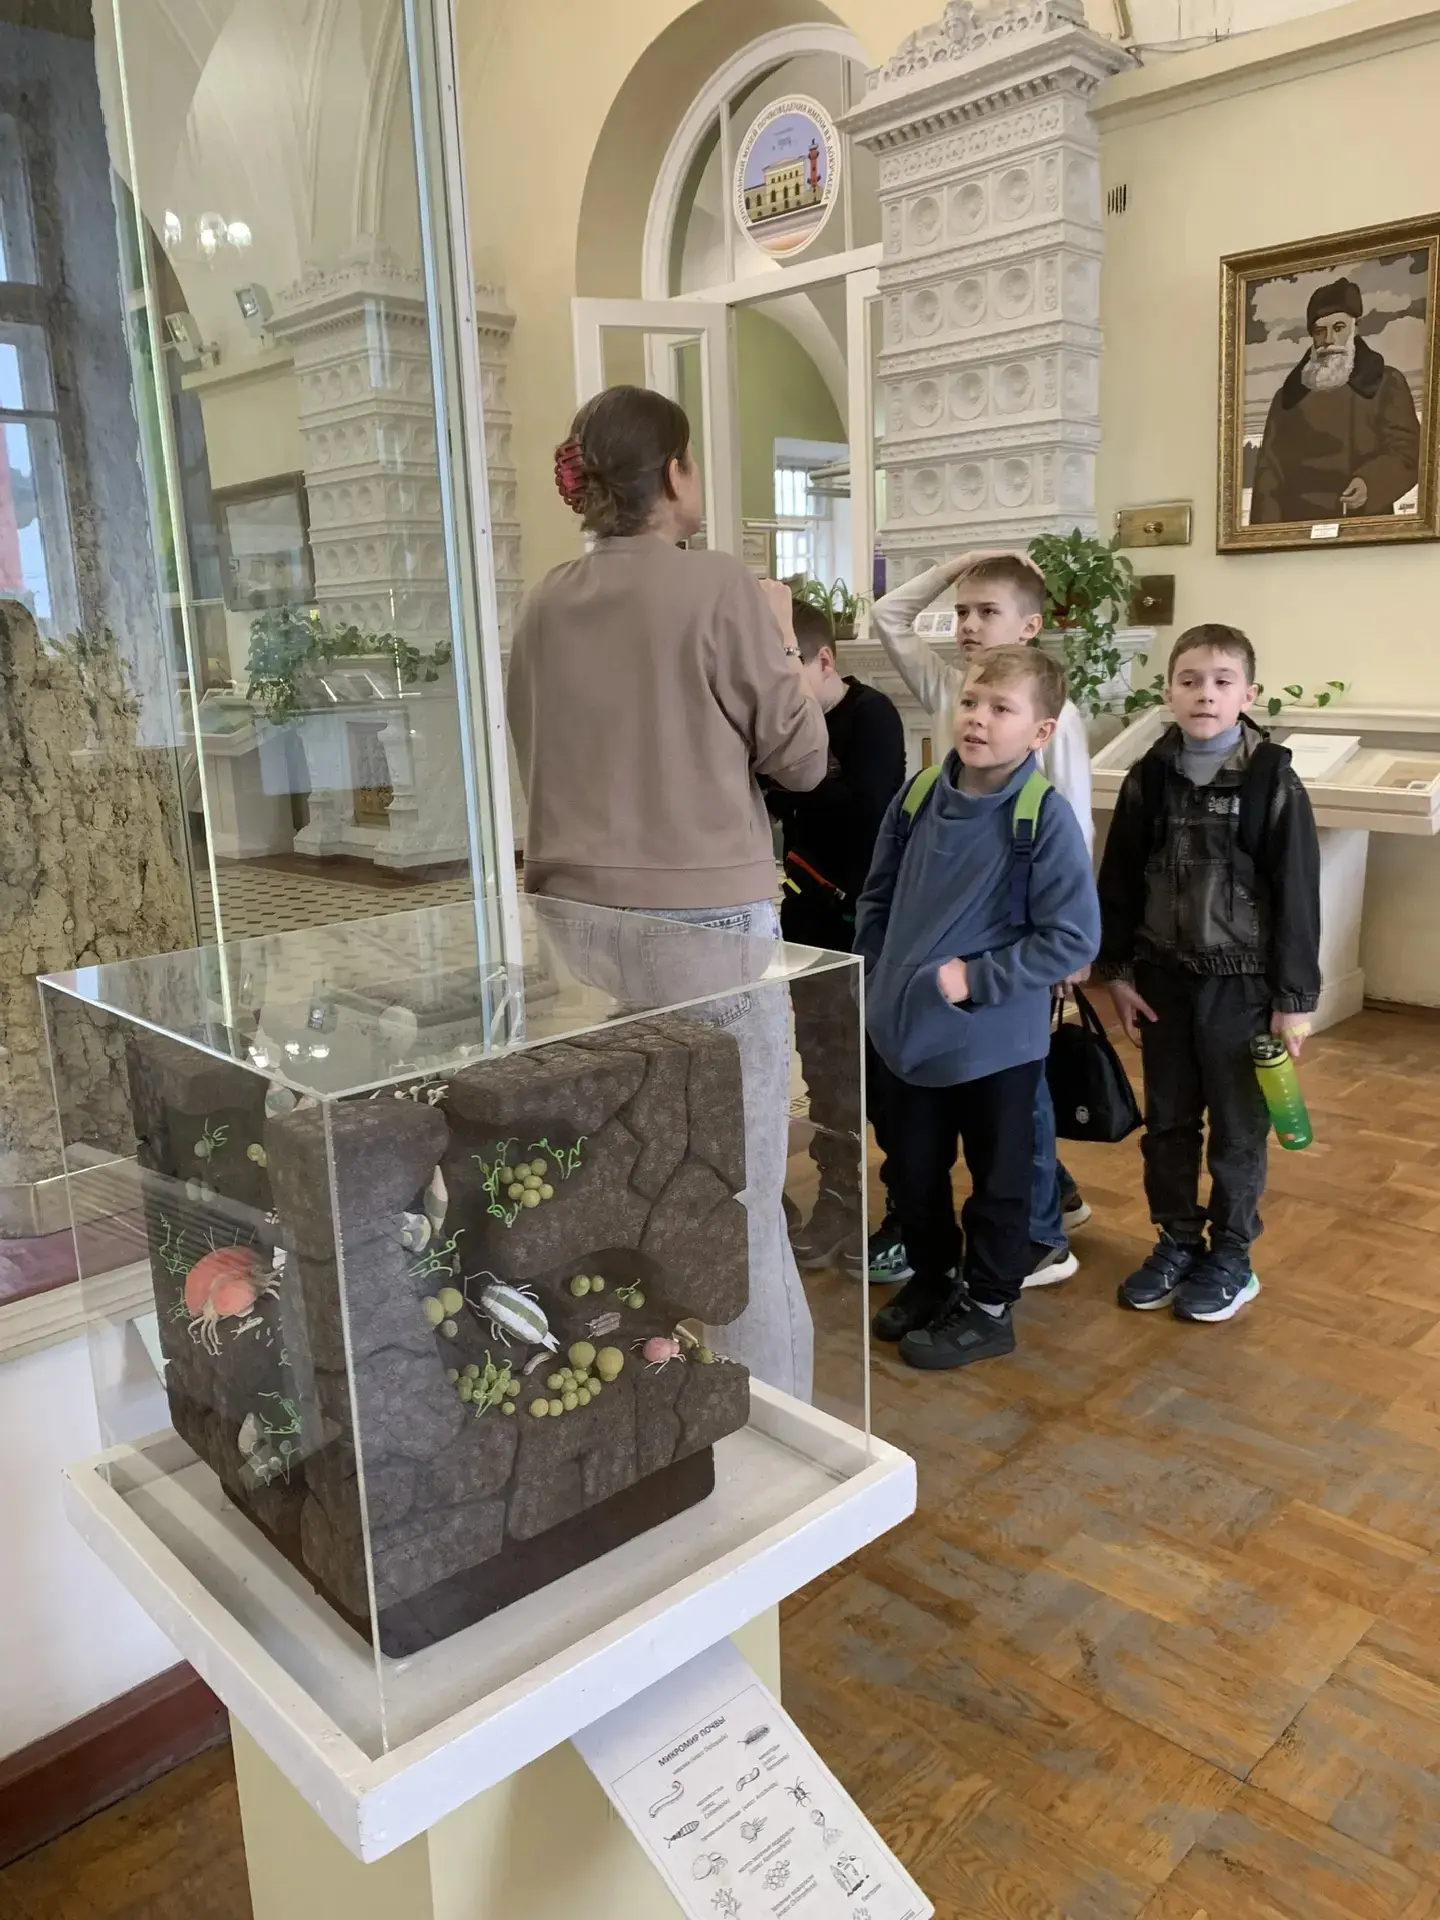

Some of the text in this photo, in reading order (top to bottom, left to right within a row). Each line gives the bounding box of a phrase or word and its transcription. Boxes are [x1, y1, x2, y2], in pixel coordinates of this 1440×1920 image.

[743, 129, 758, 160] МУЗЕЙ
[658, 1733, 700, 1767] МИКРОМИР
[699, 1716, 726, 1738] ПОЧВЫ
